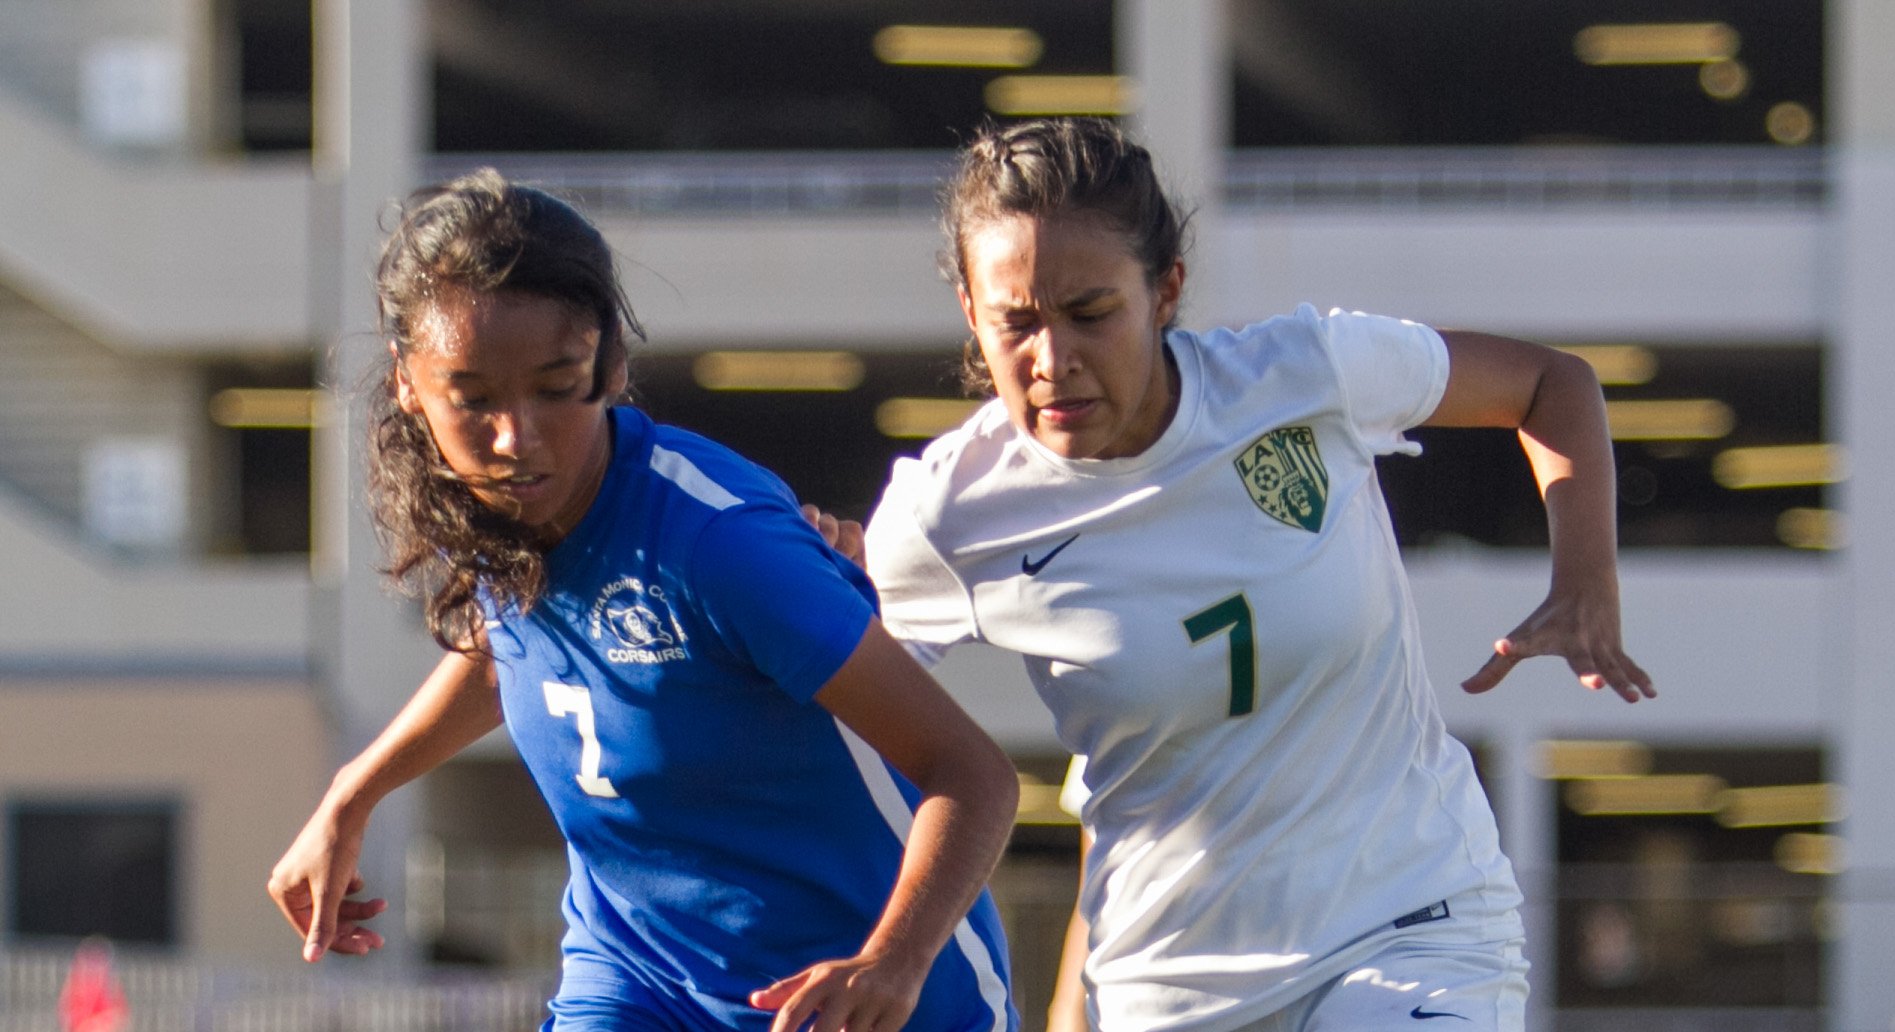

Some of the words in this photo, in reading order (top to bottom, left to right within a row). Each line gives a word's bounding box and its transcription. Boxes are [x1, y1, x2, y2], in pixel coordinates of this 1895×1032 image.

[607, 648, 686, 664] CORSAIRS
[1179, 590, 1257, 719] 7
[543, 681, 620, 798] 7
